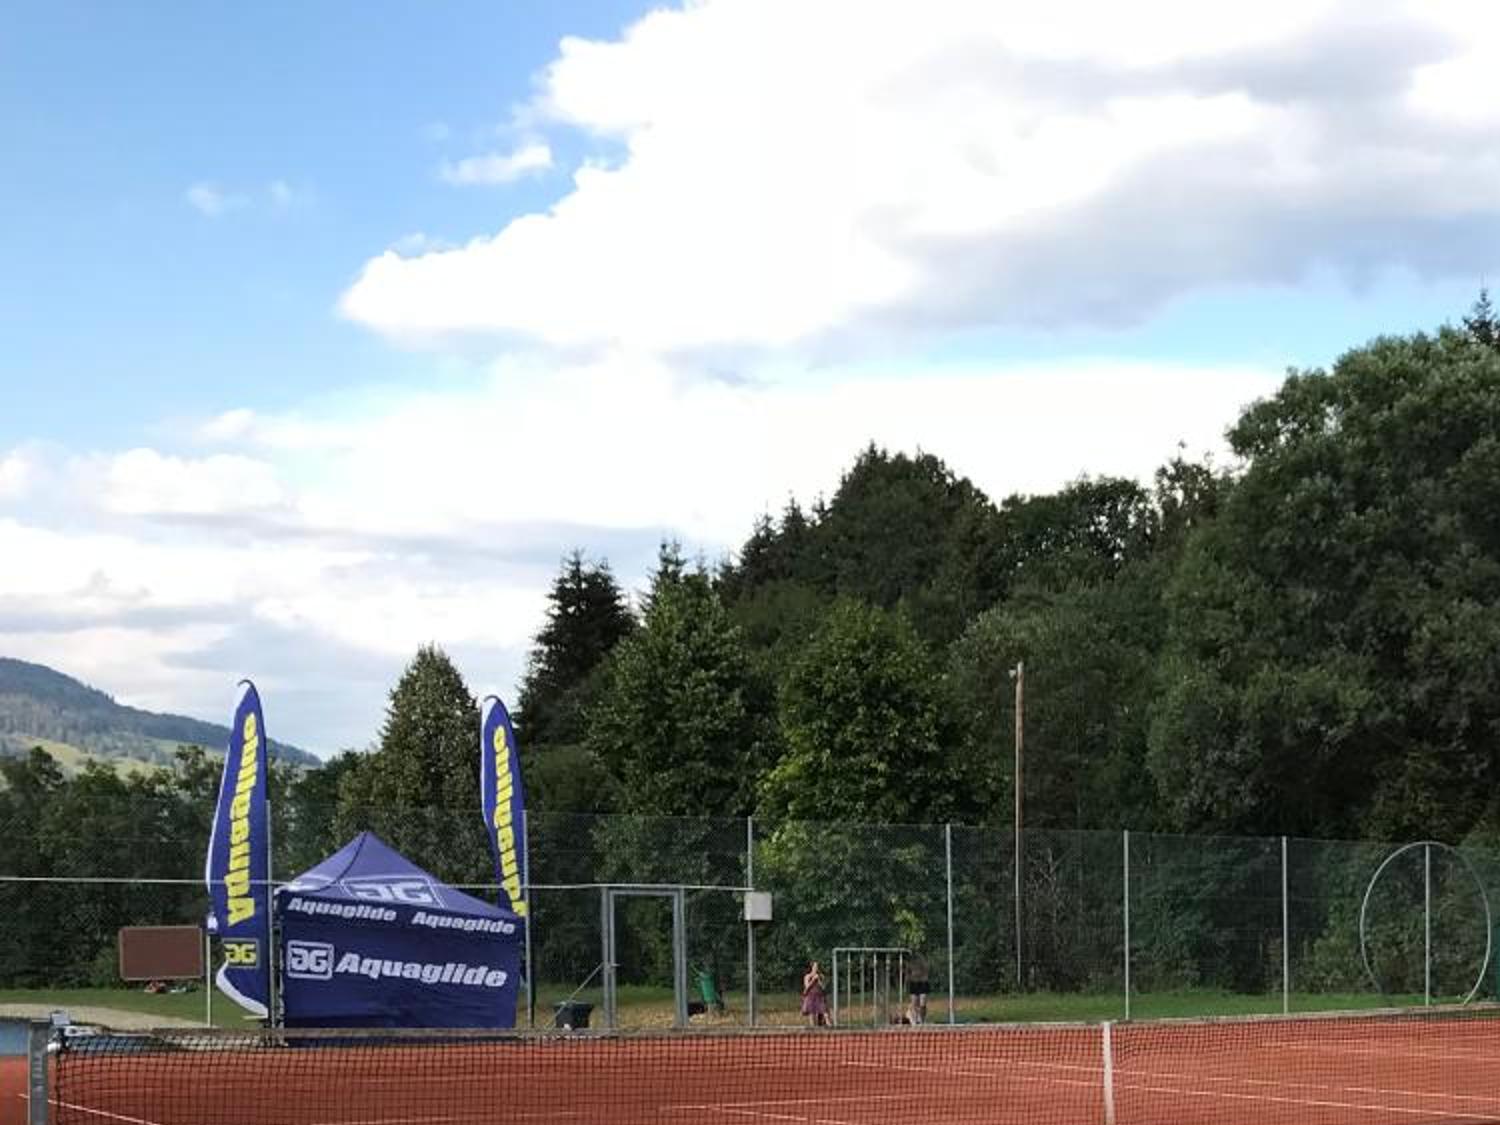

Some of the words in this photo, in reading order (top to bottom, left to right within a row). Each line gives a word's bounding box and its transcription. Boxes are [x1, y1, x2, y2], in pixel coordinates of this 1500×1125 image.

[288, 897, 398, 922] Aquaglide
[411, 911, 516, 935] Aquaglide
[335, 952, 509, 988] Aquaglide
